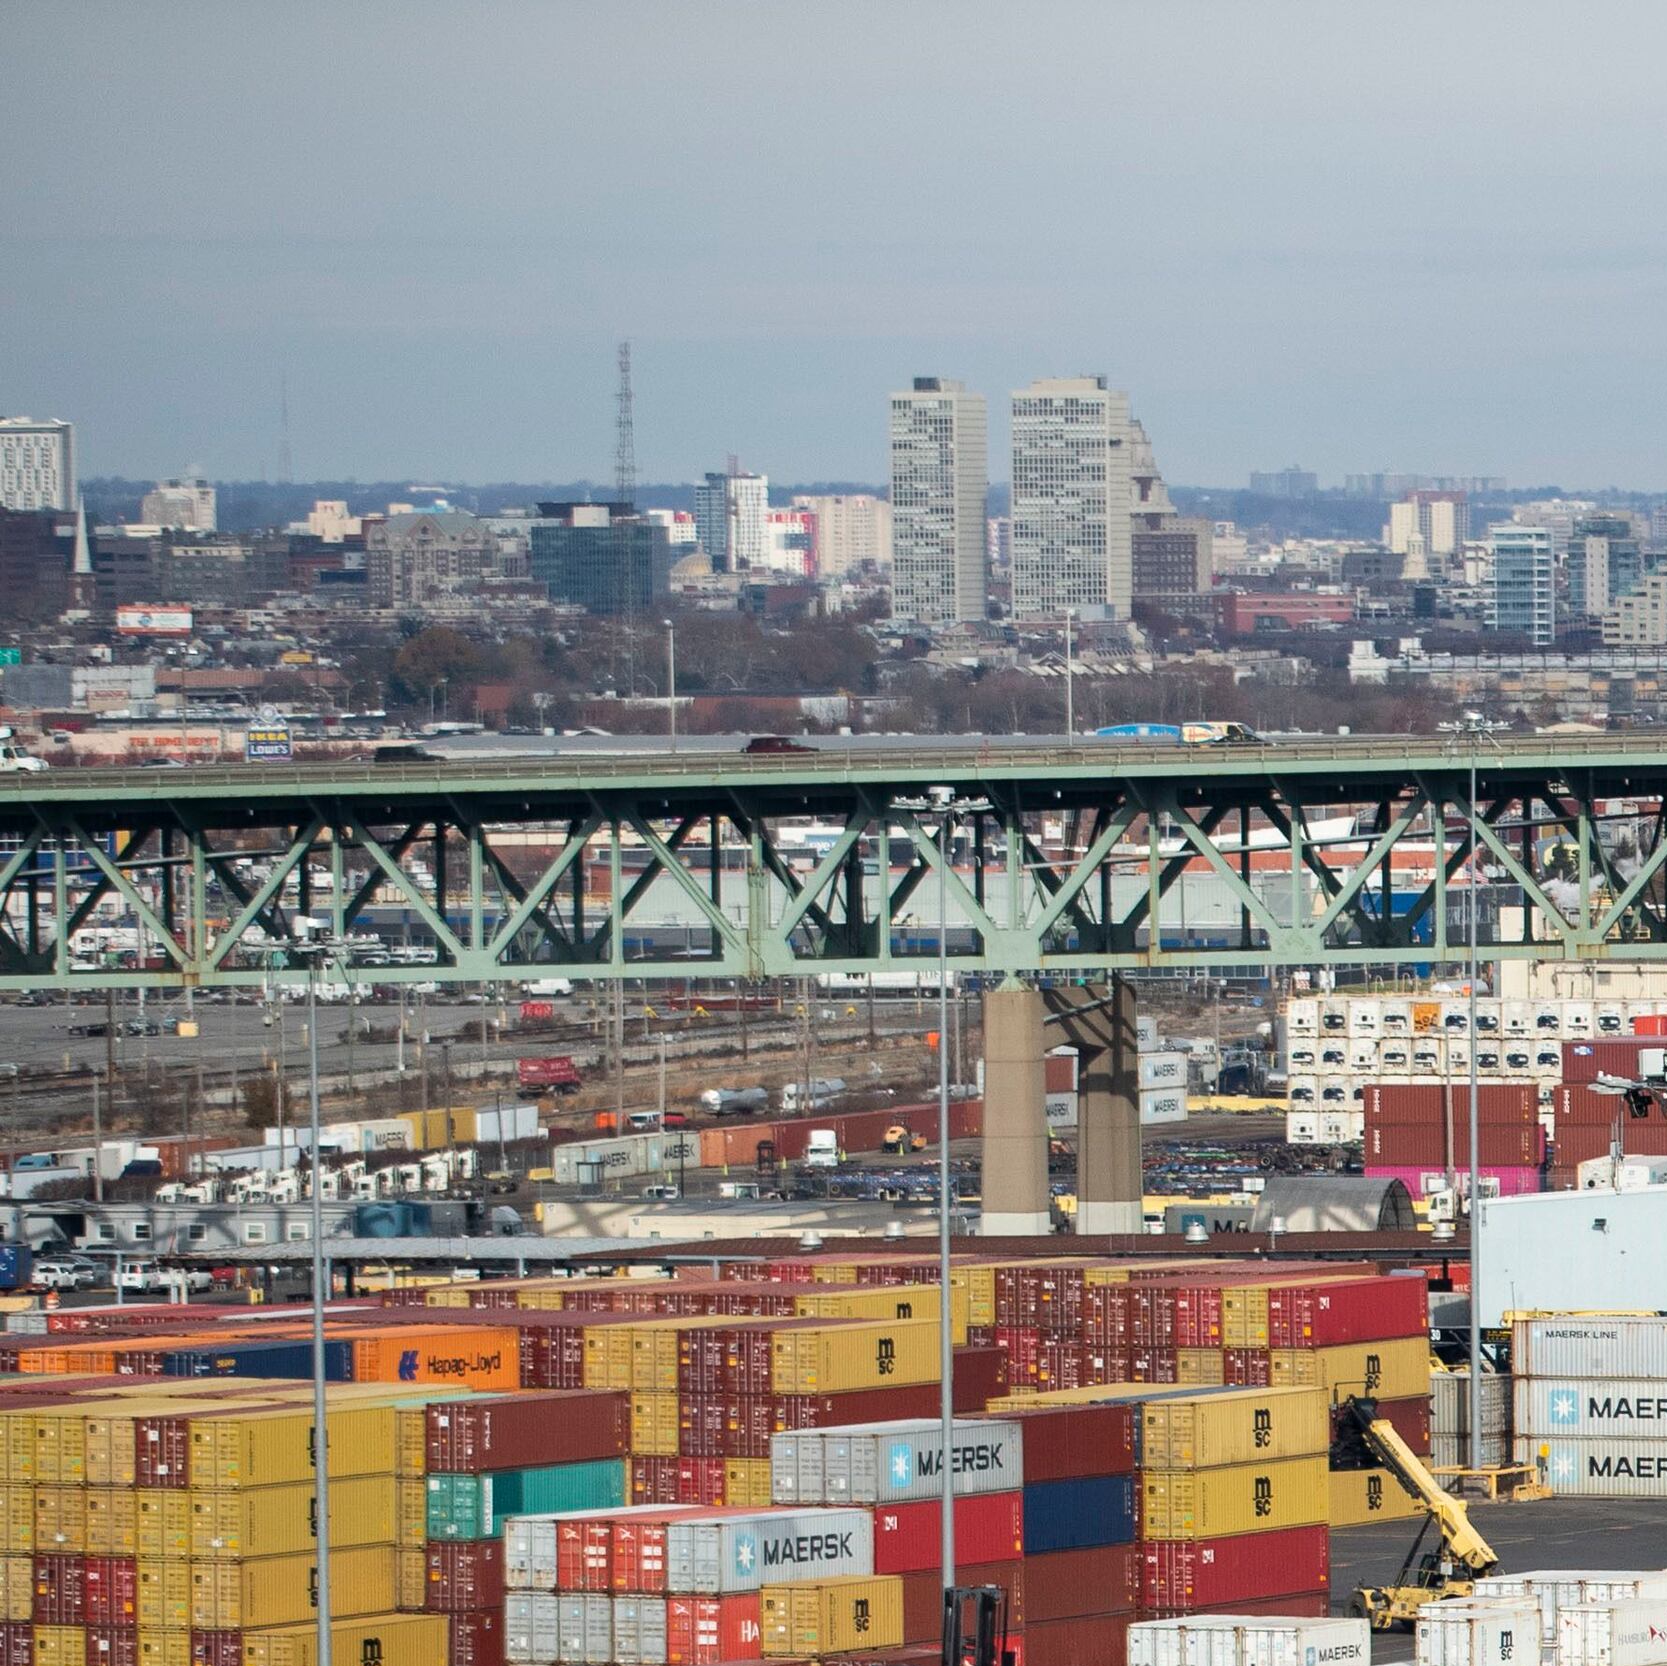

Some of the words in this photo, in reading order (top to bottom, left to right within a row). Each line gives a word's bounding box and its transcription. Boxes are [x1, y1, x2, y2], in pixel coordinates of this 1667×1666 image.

[1546, 1331, 1590, 1339] MAERSK
[1593, 1331, 1617, 1339] LINE
[427, 1353, 499, 1375] Hapag-Lloyd
[763, 1532, 852, 1566] MAERSK
[1319, 1643, 1362, 1661] MAERSK
